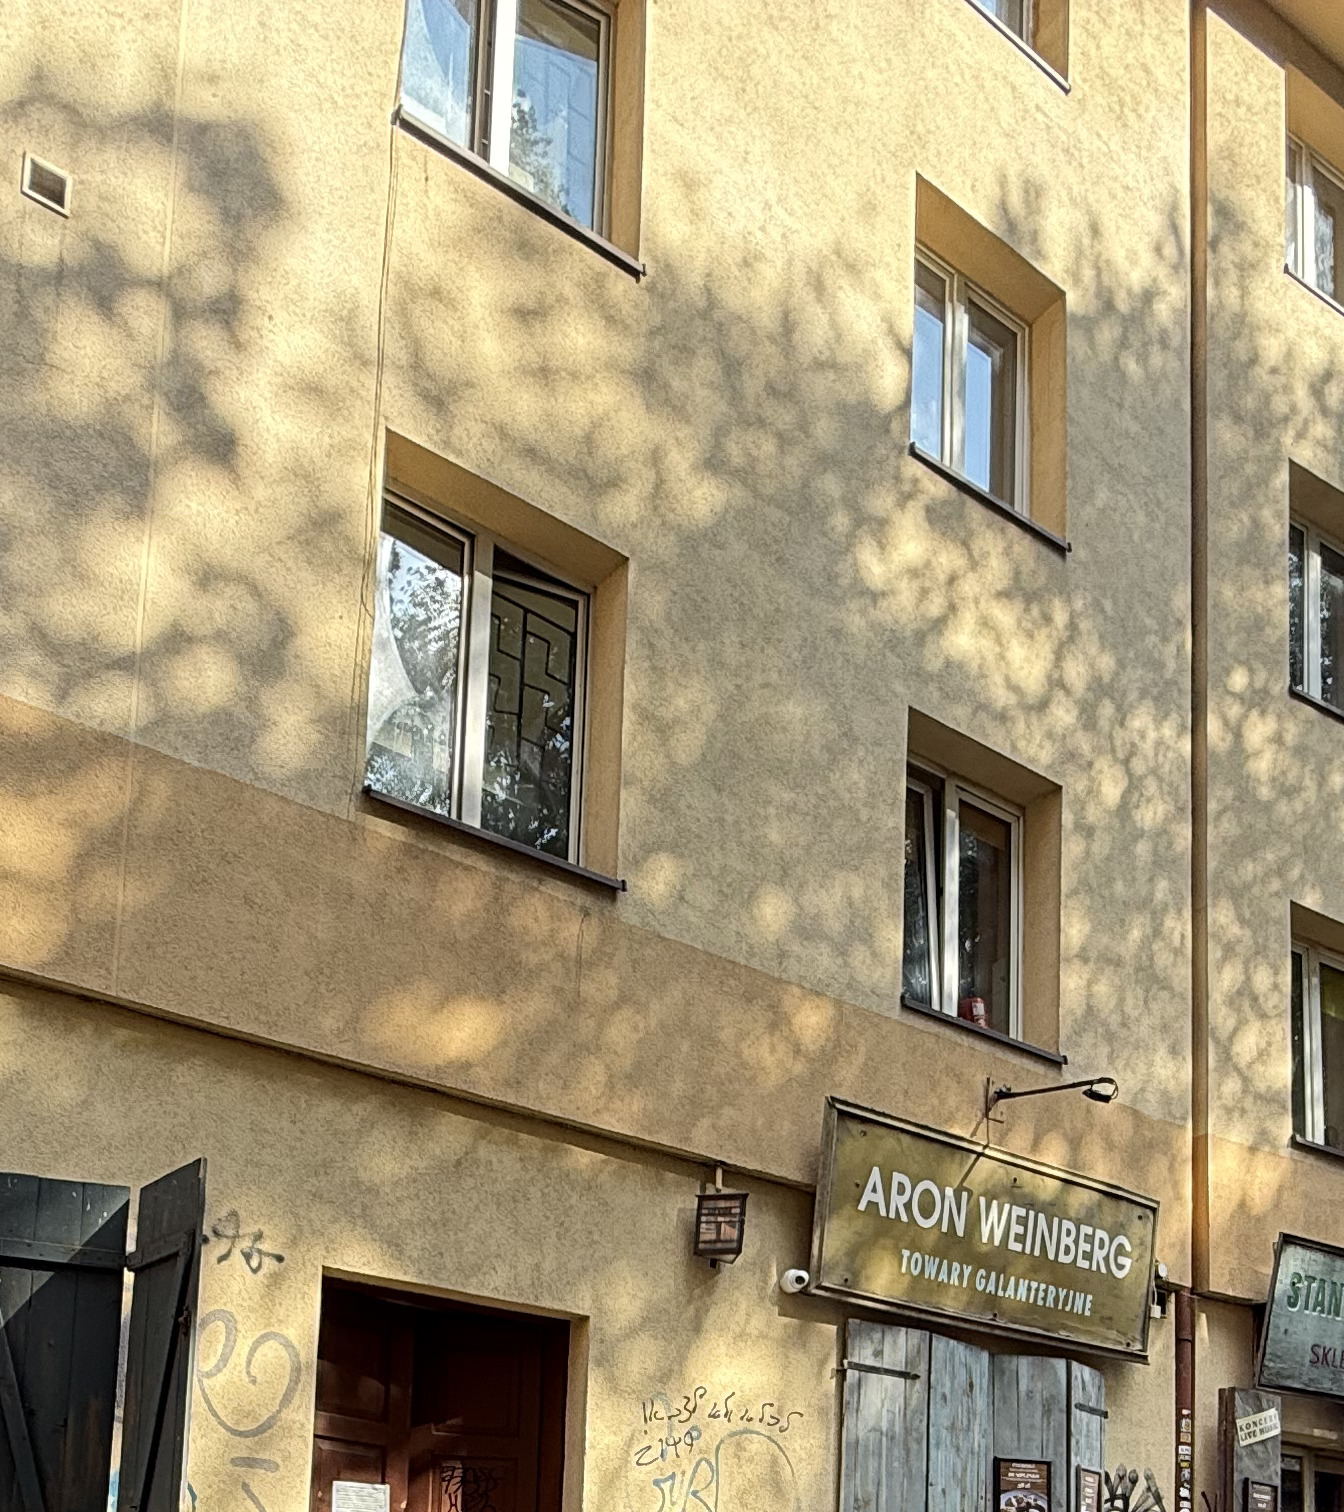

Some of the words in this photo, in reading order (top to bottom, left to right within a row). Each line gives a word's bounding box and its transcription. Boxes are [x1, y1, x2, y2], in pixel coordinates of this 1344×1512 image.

[857, 1166, 968, 1238] ARON
[979, 1196, 1133, 1279] WEINBERG
[900, 1249, 973, 1288] TOWARY
[975, 1269, 1094, 1317] GALANTERYJNE
